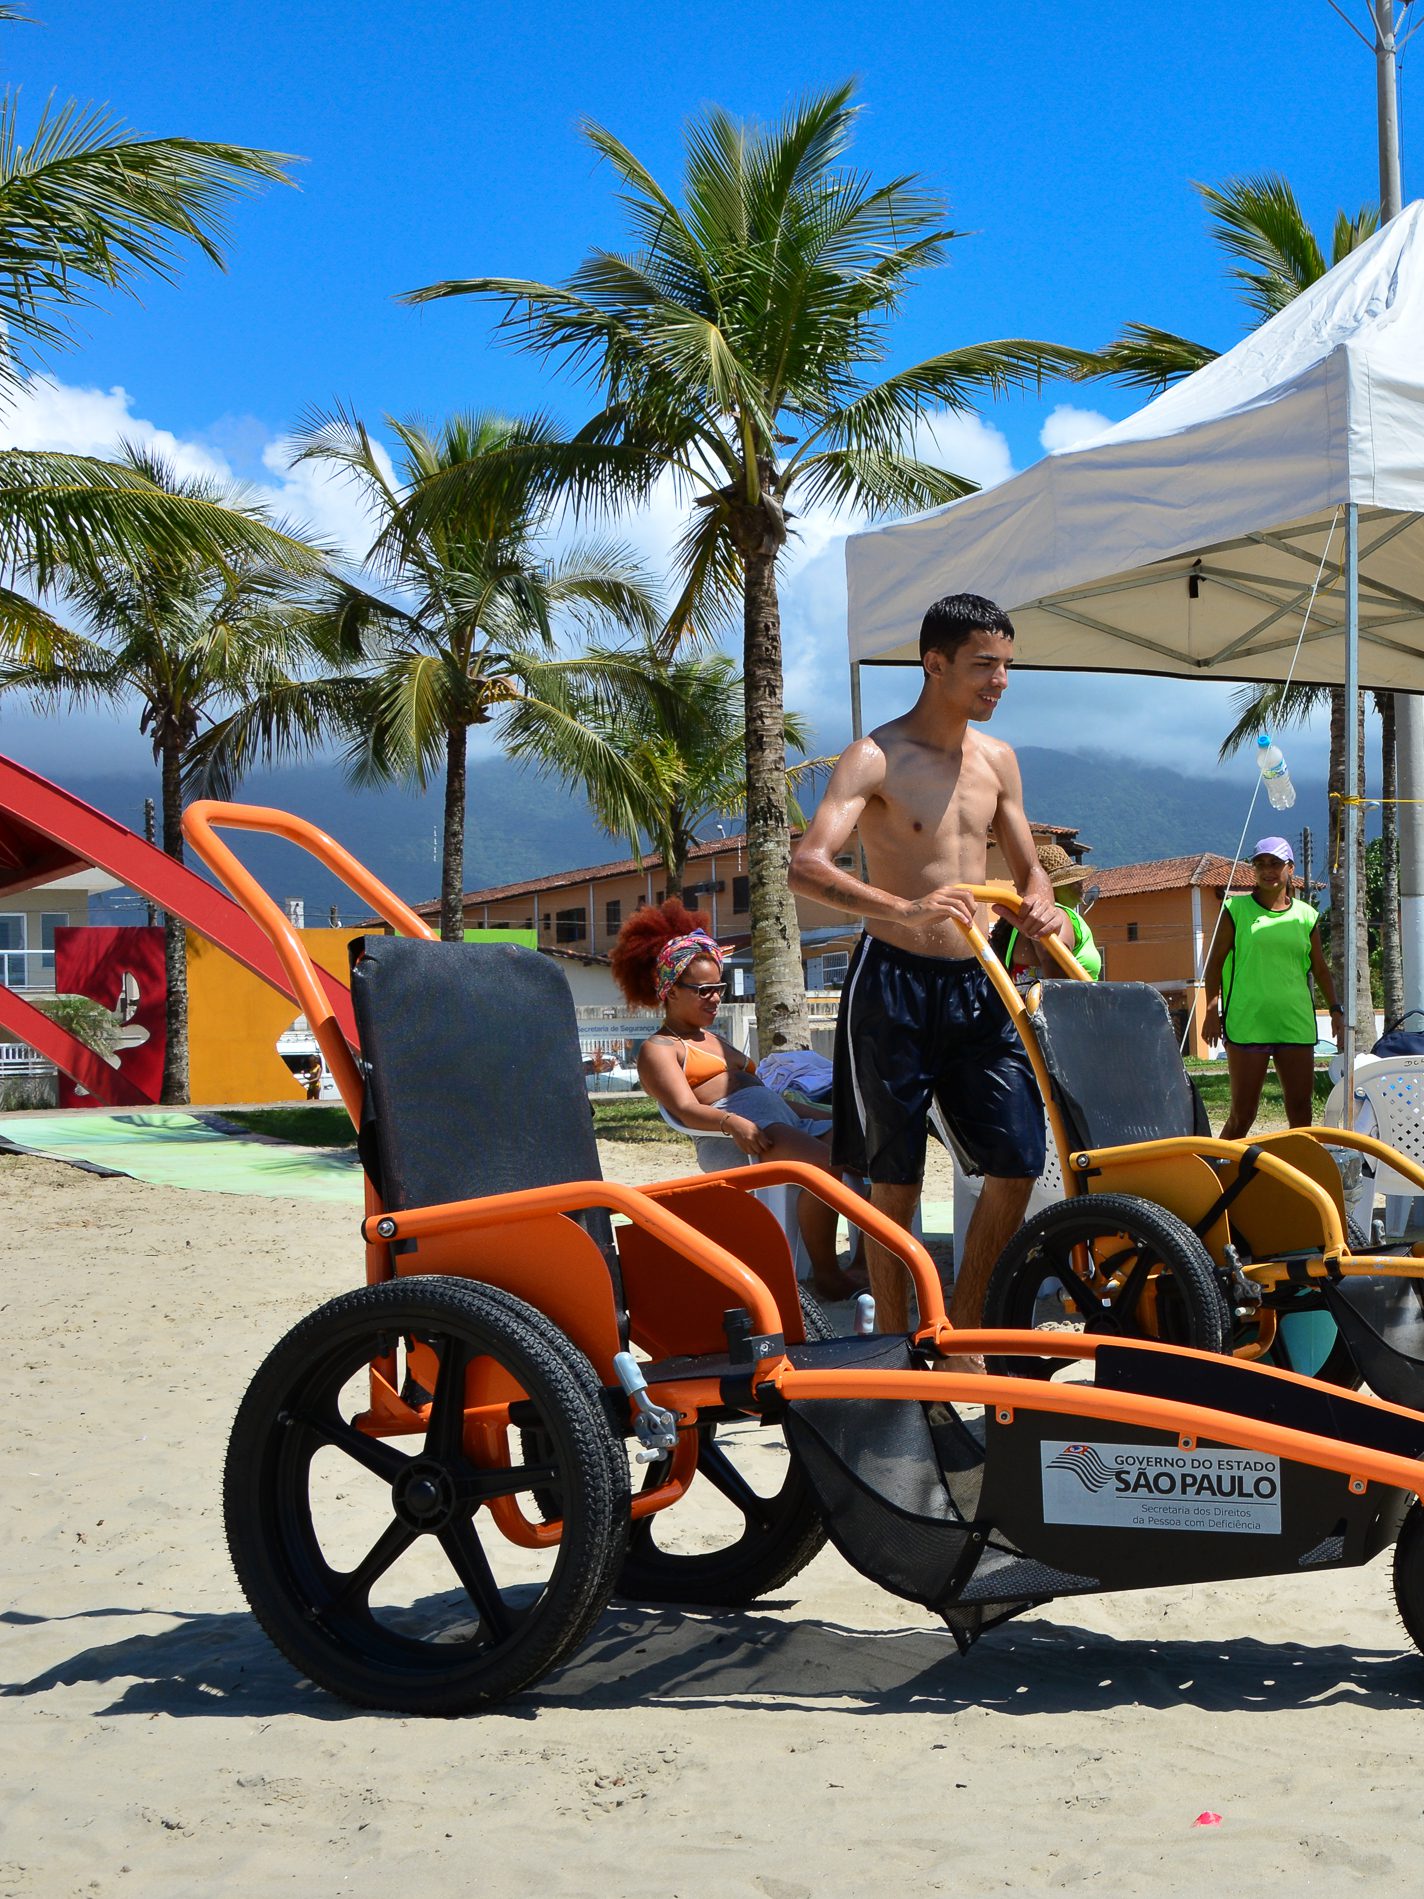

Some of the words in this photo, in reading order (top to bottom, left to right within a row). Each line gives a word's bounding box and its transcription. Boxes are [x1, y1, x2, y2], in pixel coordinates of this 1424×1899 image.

[620, 1024, 655, 1033] Segurança
[1114, 1455, 1186, 1469] GOVERNO
[1191, 1458, 1213, 1470] DO
[1217, 1460, 1276, 1473] ESTADO
[1115, 1466, 1176, 1495] SÃO
[1180, 1473, 1277, 1499] PAULO
[1141, 1504, 1190, 1516] Secretaria
[1193, 1506, 1210, 1516] dos
[1214, 1507, 1252, 1518] Direitos
[1132, 1516, 1145, 1525] da
[1148, 1517, 1181, 1527] Pessoa
[1184, 1519, 1205, 1528] com
[1208, 1518, 1261, 1530] Deficiência
